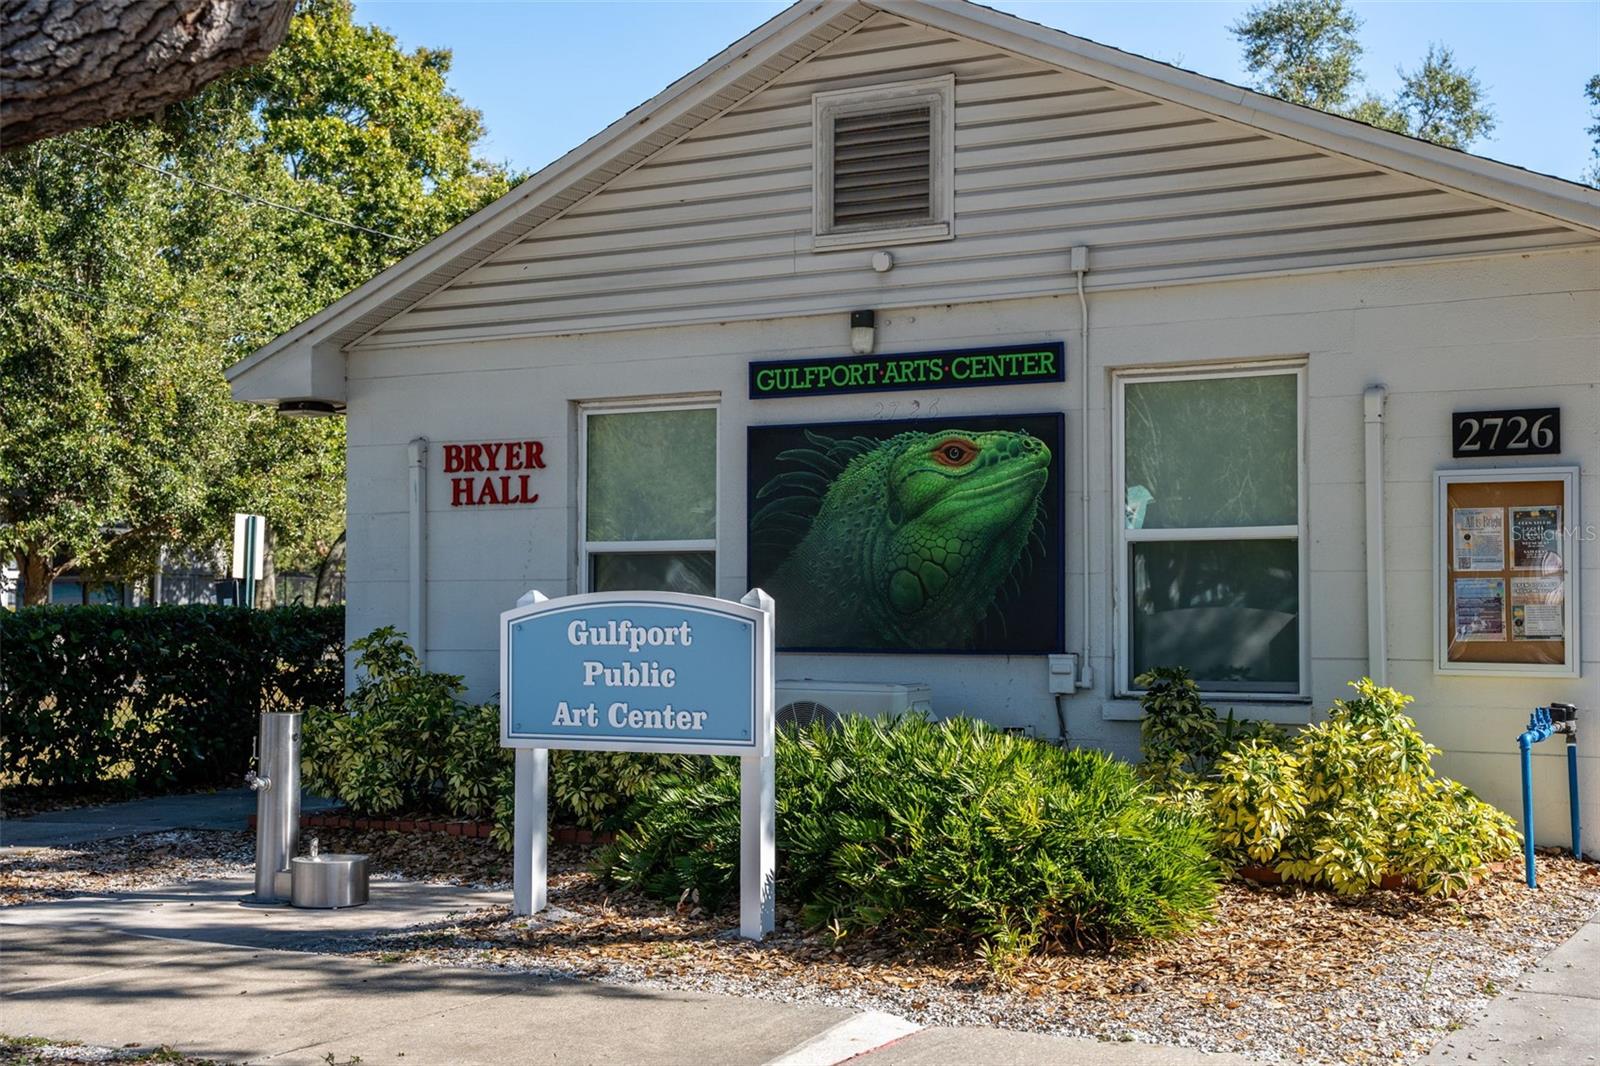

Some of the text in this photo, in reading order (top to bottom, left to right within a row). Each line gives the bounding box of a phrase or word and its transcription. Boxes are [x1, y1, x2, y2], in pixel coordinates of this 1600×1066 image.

[756, 352, 1056, 391] GULFPORT ARTS CENTER
[1458, 414, 1554, 451] 2726
[442, 441, 546, 473] BRYER
[451, 475, 539, 507] HALL
[567, 619, 692, 653] Gulfport
[583, 661, 676, 688] Public
[551, 701, 708, 731] Art Center
